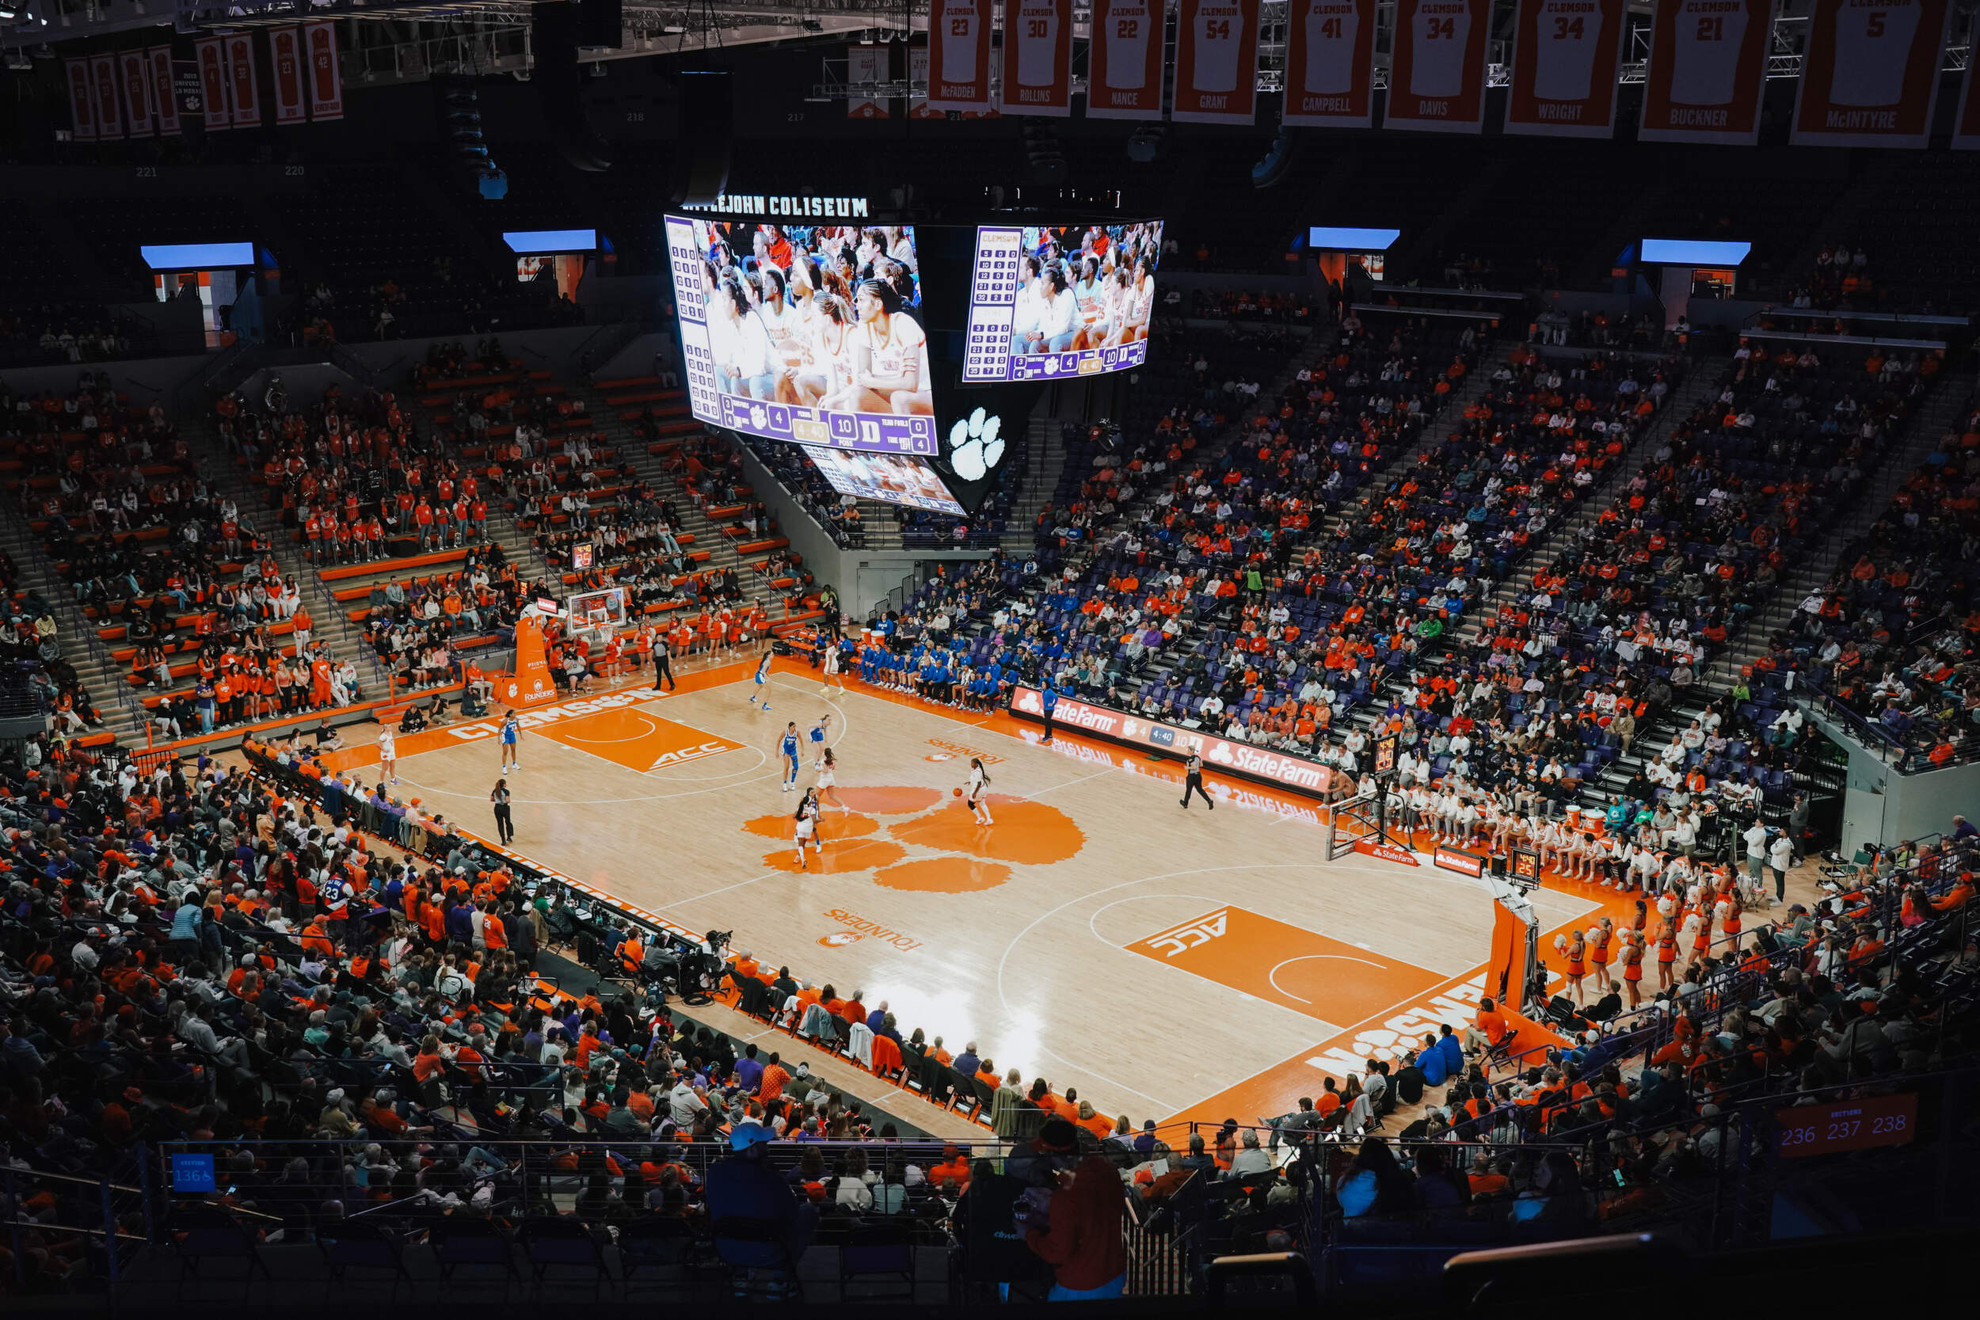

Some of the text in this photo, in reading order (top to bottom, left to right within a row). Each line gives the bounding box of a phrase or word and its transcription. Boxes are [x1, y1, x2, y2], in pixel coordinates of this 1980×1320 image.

[1111, 7, 1145, 17] CLEMSON
[1201, 7, 1237, 17] CLEMSON
[1313, 4, 1352, 14] CLEMSON
[1421, 4, 1464, 14] CLEMSON
[1547, 2, 1595, 13] CLEMSON
[1686, 1, 1740, 13] CLEMSON
[951, 19, 969, 36] 23
[1028, 20, 1048, 38] 30
[1117, 20, 1138, 39] 22
[1206, 20, 1230, 39] 54
[1321, 18, 1342, 38] 41
[1426, 17, 1454, 40] 34
[1553, 17, 1584, 40] 34
[1696, 17, 1722, 41] 21
[1866, 12, 1887, 38] 5
[318, 57, 328, 69] 42
[941, 86, 976, 99] McFADDEN
[1019, 89, 1051, 103] ROLLINS
[1111, 92, 1138, 105] NANCE
[1199, 95, 1228, 110] GRANT
[1302, 97, 1351, 112] CAMPBELL
[1419, 100, 1448, 116] DAVIS
[627, 113, 644, 122] 218
[1538, 103, 1583, 120] WRIGHT
[1669, 108, 1728, 127] BUCKNER
[1826, 110, 1897, 129] McINTYRE
[136, 167, 157, 177] 221
[285, 165, 304, 176] 220
[769, 196, 868, 217] COLISEUM
[1066, 357, 1073, 368] 4
[1107, 351, 1116, 363] 10
[775, 411, 783, 424] 4
[838, 419, 852, 433] 10
[860, 420, 880, 443] D
[915, 422, 922, 431] 0
[917, 440, 924, 449] 4
[524, 688, 555, 702] FOUNDERS
[1139, 725, 1146, 737] 4
[1153, 729, 1172, 742] 4:40
[1175, 735, 1188, 747] 10
[652, 741, 727, 767] ACC
[1233, 746, 1325, 788] StateFarm
[1381, 850, 1414, 864] StateFarm
[1445, 856, 1478, 871] StateFarm
[1519, 853, 1535, 865] 4:40
[1519, 863, 1532, 876] 25
[325, 886, 339, 900] 23
[823, 907, 924, 952] FOUNDERS
[1152, 915, 1227, 957] ACC
[1781, 1114, 1907, 1146] 236 237 238
[175, 1169, 200, 1182] 136
